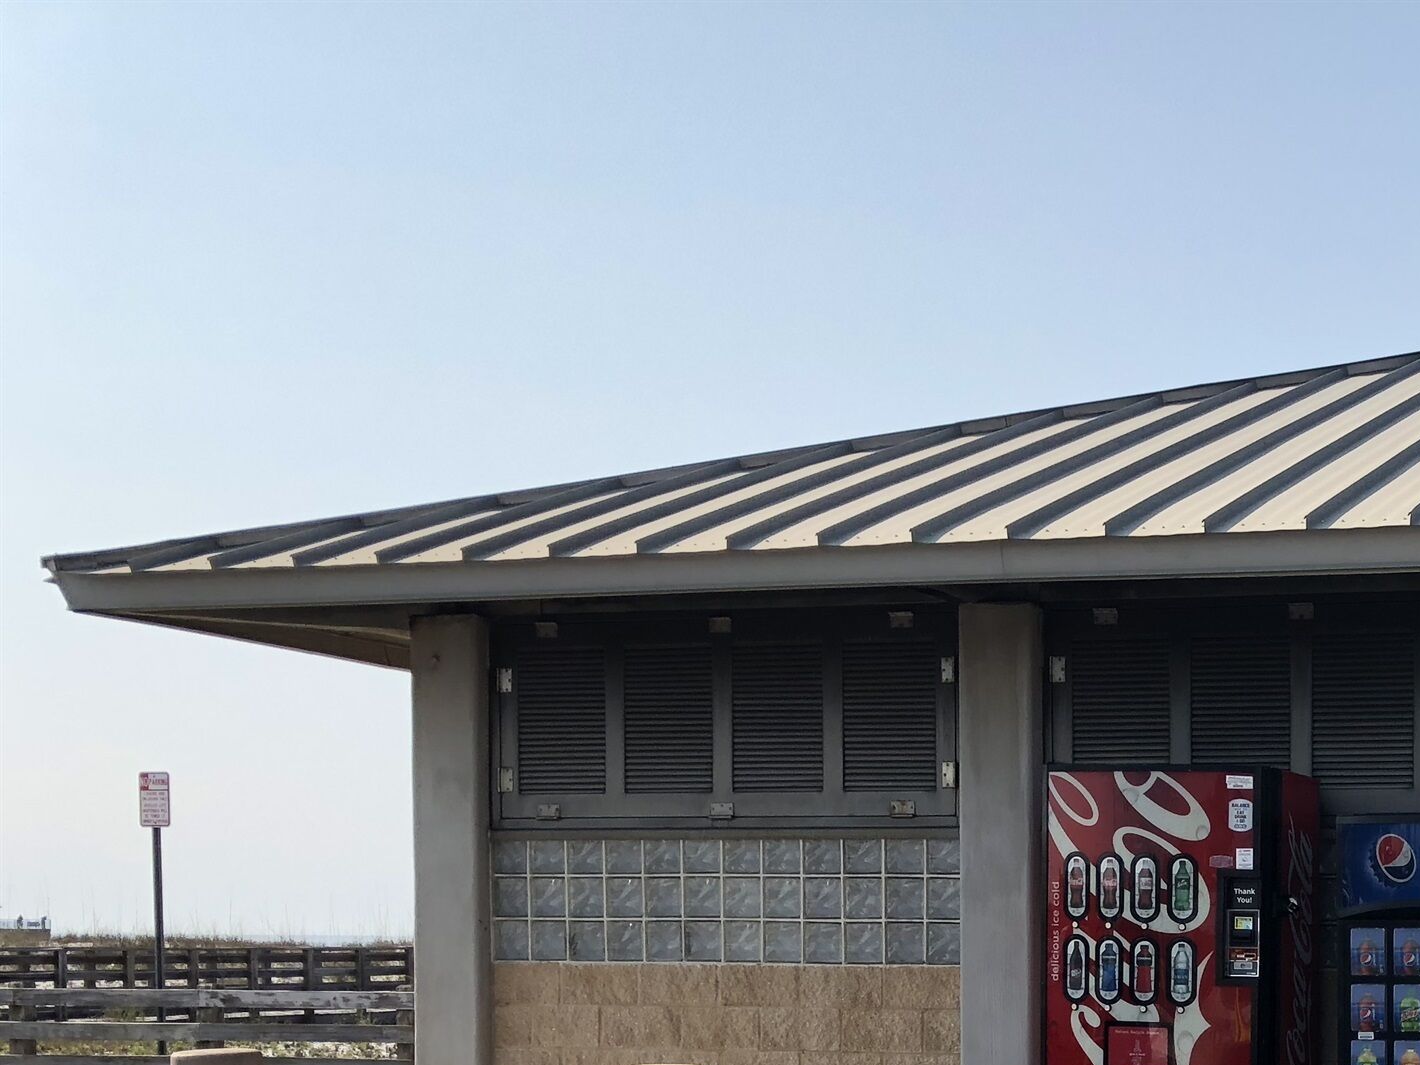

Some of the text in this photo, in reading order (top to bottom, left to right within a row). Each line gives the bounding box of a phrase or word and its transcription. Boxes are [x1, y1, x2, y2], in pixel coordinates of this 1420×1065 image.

[1051, 881, 1060, 981] delicious ice cold
